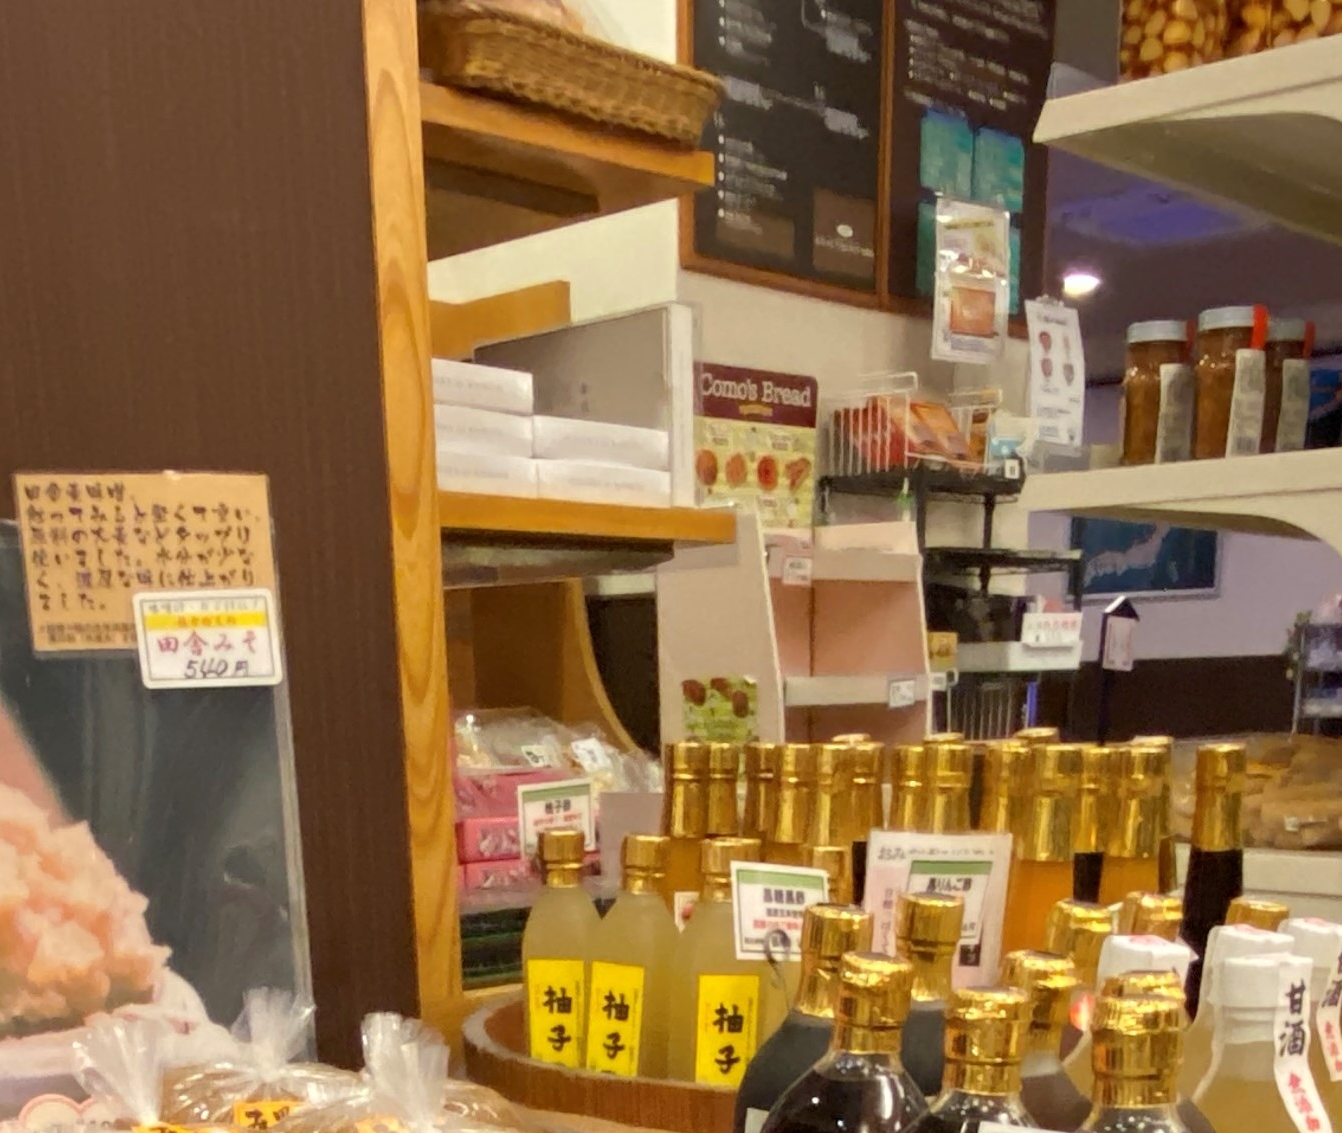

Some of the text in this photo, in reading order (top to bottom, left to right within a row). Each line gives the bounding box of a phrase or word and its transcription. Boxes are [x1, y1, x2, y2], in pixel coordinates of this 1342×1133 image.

[762, 381, 811, 407] Bread
[543, 985, 573, 1052] 柚子
[602, 990, 630, 1060] 柚子
[712, 1002, 745, 1075] 柚子
[1279, 978, 1307, 1058] 甘酒
